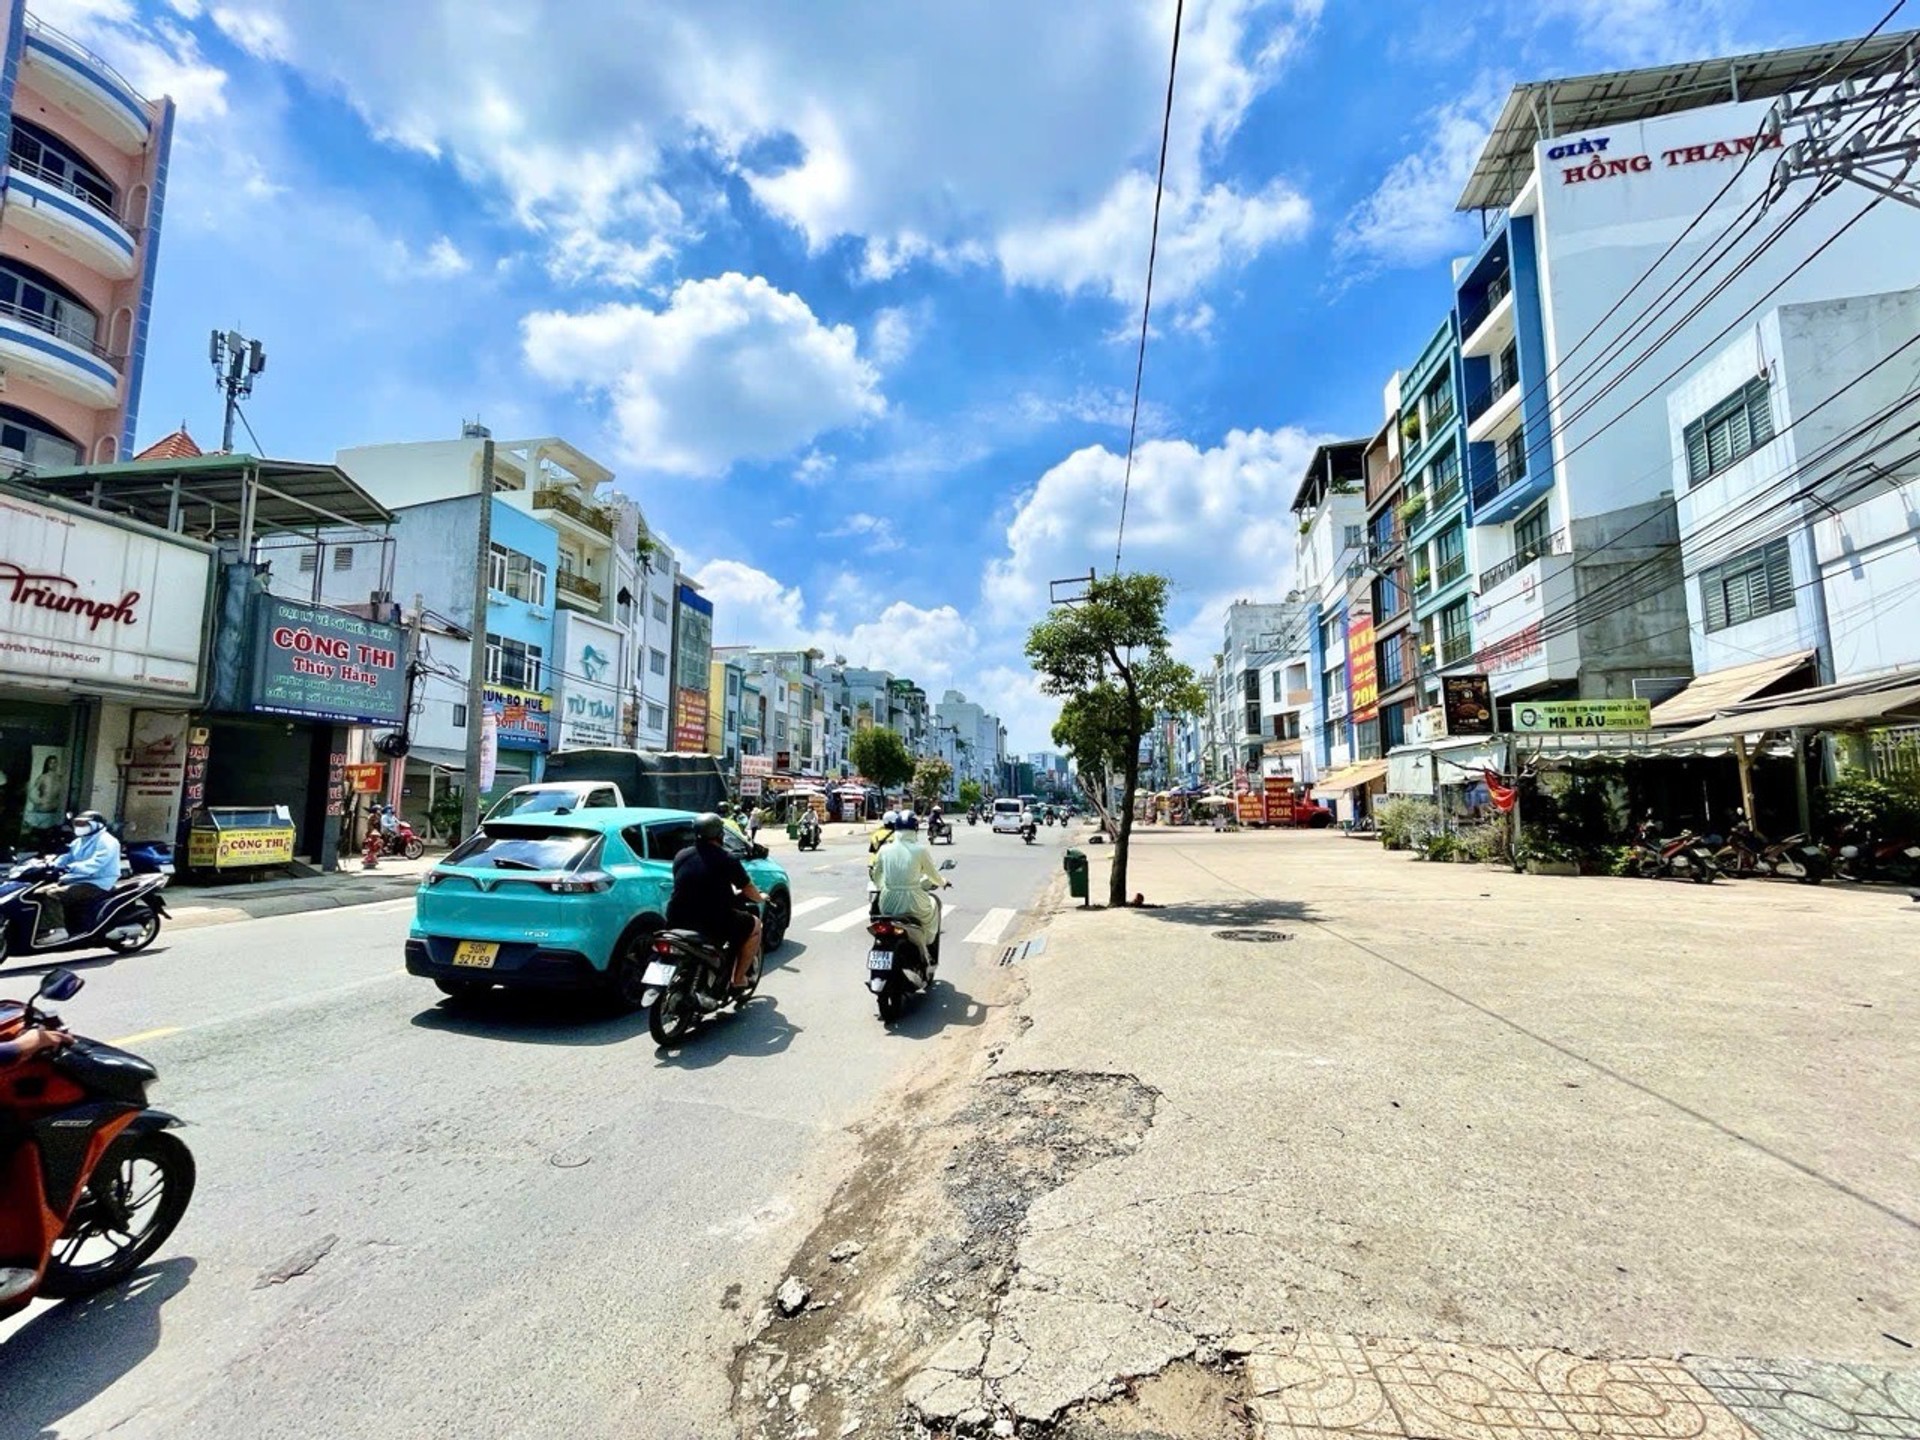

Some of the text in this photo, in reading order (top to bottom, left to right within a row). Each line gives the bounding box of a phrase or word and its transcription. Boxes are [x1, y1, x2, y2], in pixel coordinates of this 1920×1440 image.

[1547, 138, 1610, 161] GIÀY
[1662, 133, 1784, 165] THẠNH
[0, 562, 141, 631] Triumph
[274, 627, 396, 670] CÔNG THI
[1549, 717, 1572, 728] MR.
[1575, 712, 1606, 728] RÂU
[265, 838, 284, 848] THI
